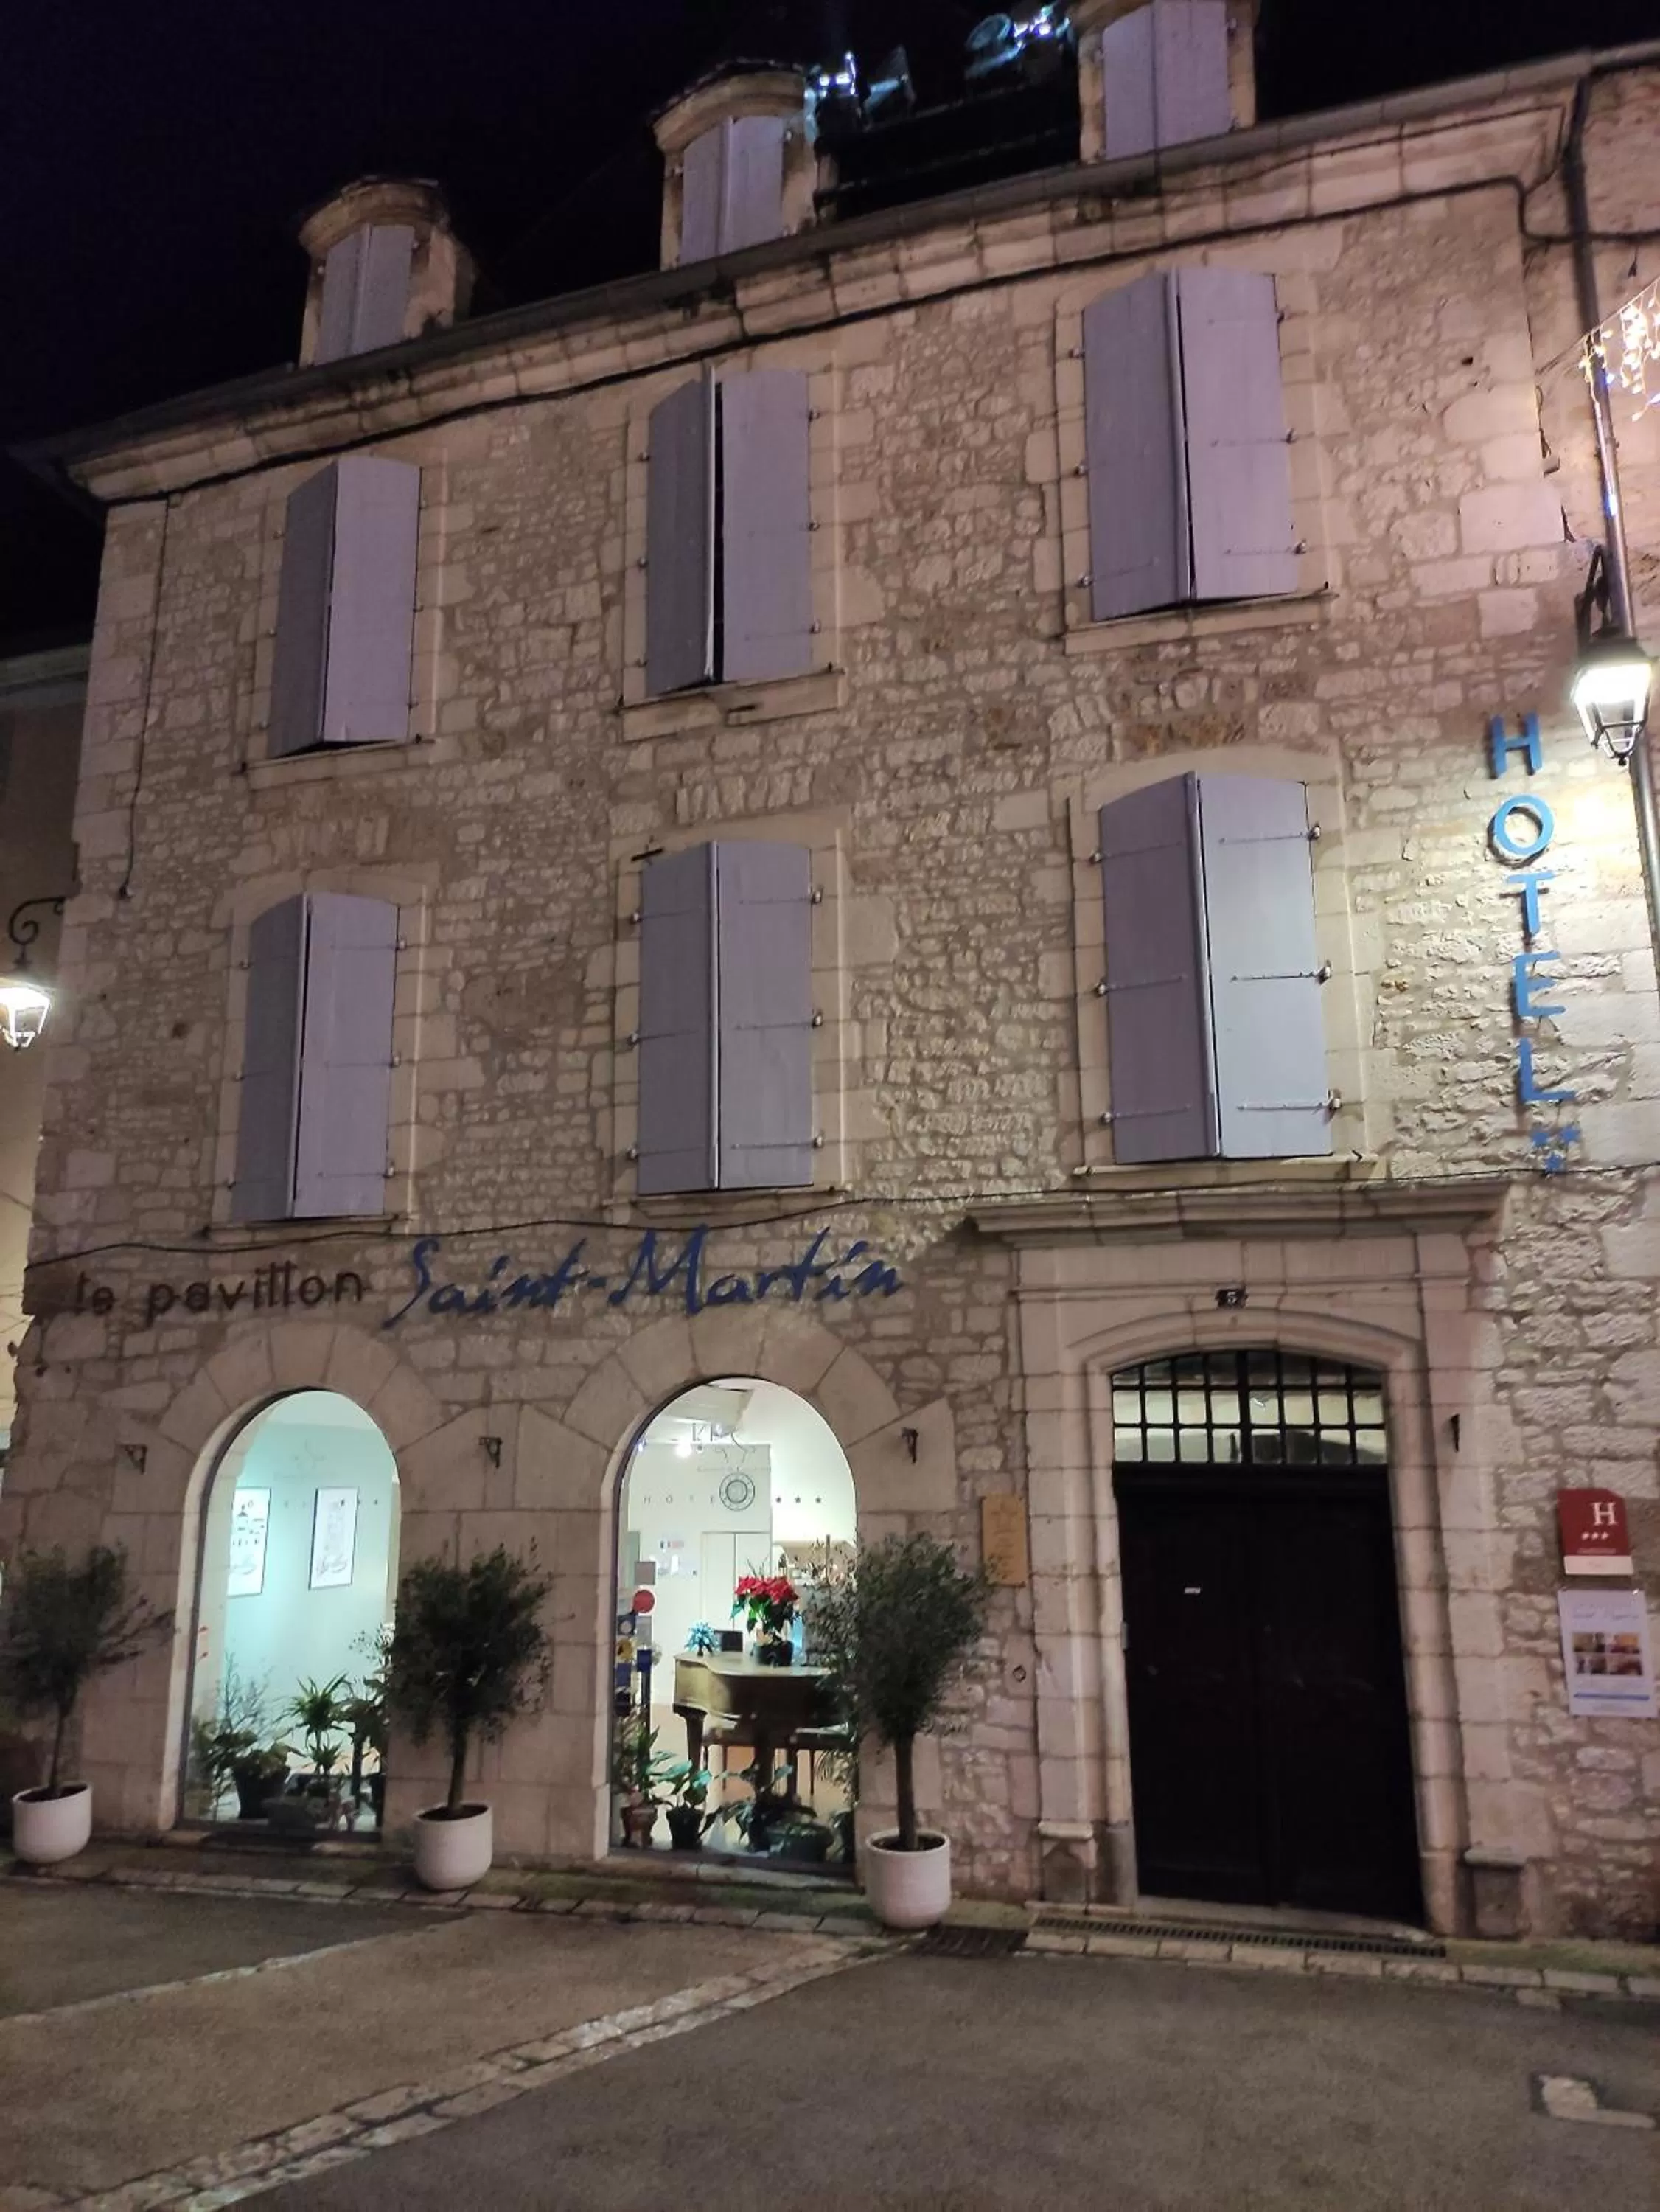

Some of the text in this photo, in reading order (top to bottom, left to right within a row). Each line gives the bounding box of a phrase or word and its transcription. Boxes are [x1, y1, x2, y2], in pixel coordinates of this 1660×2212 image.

[1490, 712, 1576, 1103] HOTEL
[76, 1225, 904, 1330] le pavillon Saint-Martin
[1591, 1501, 1618, 1526] H
